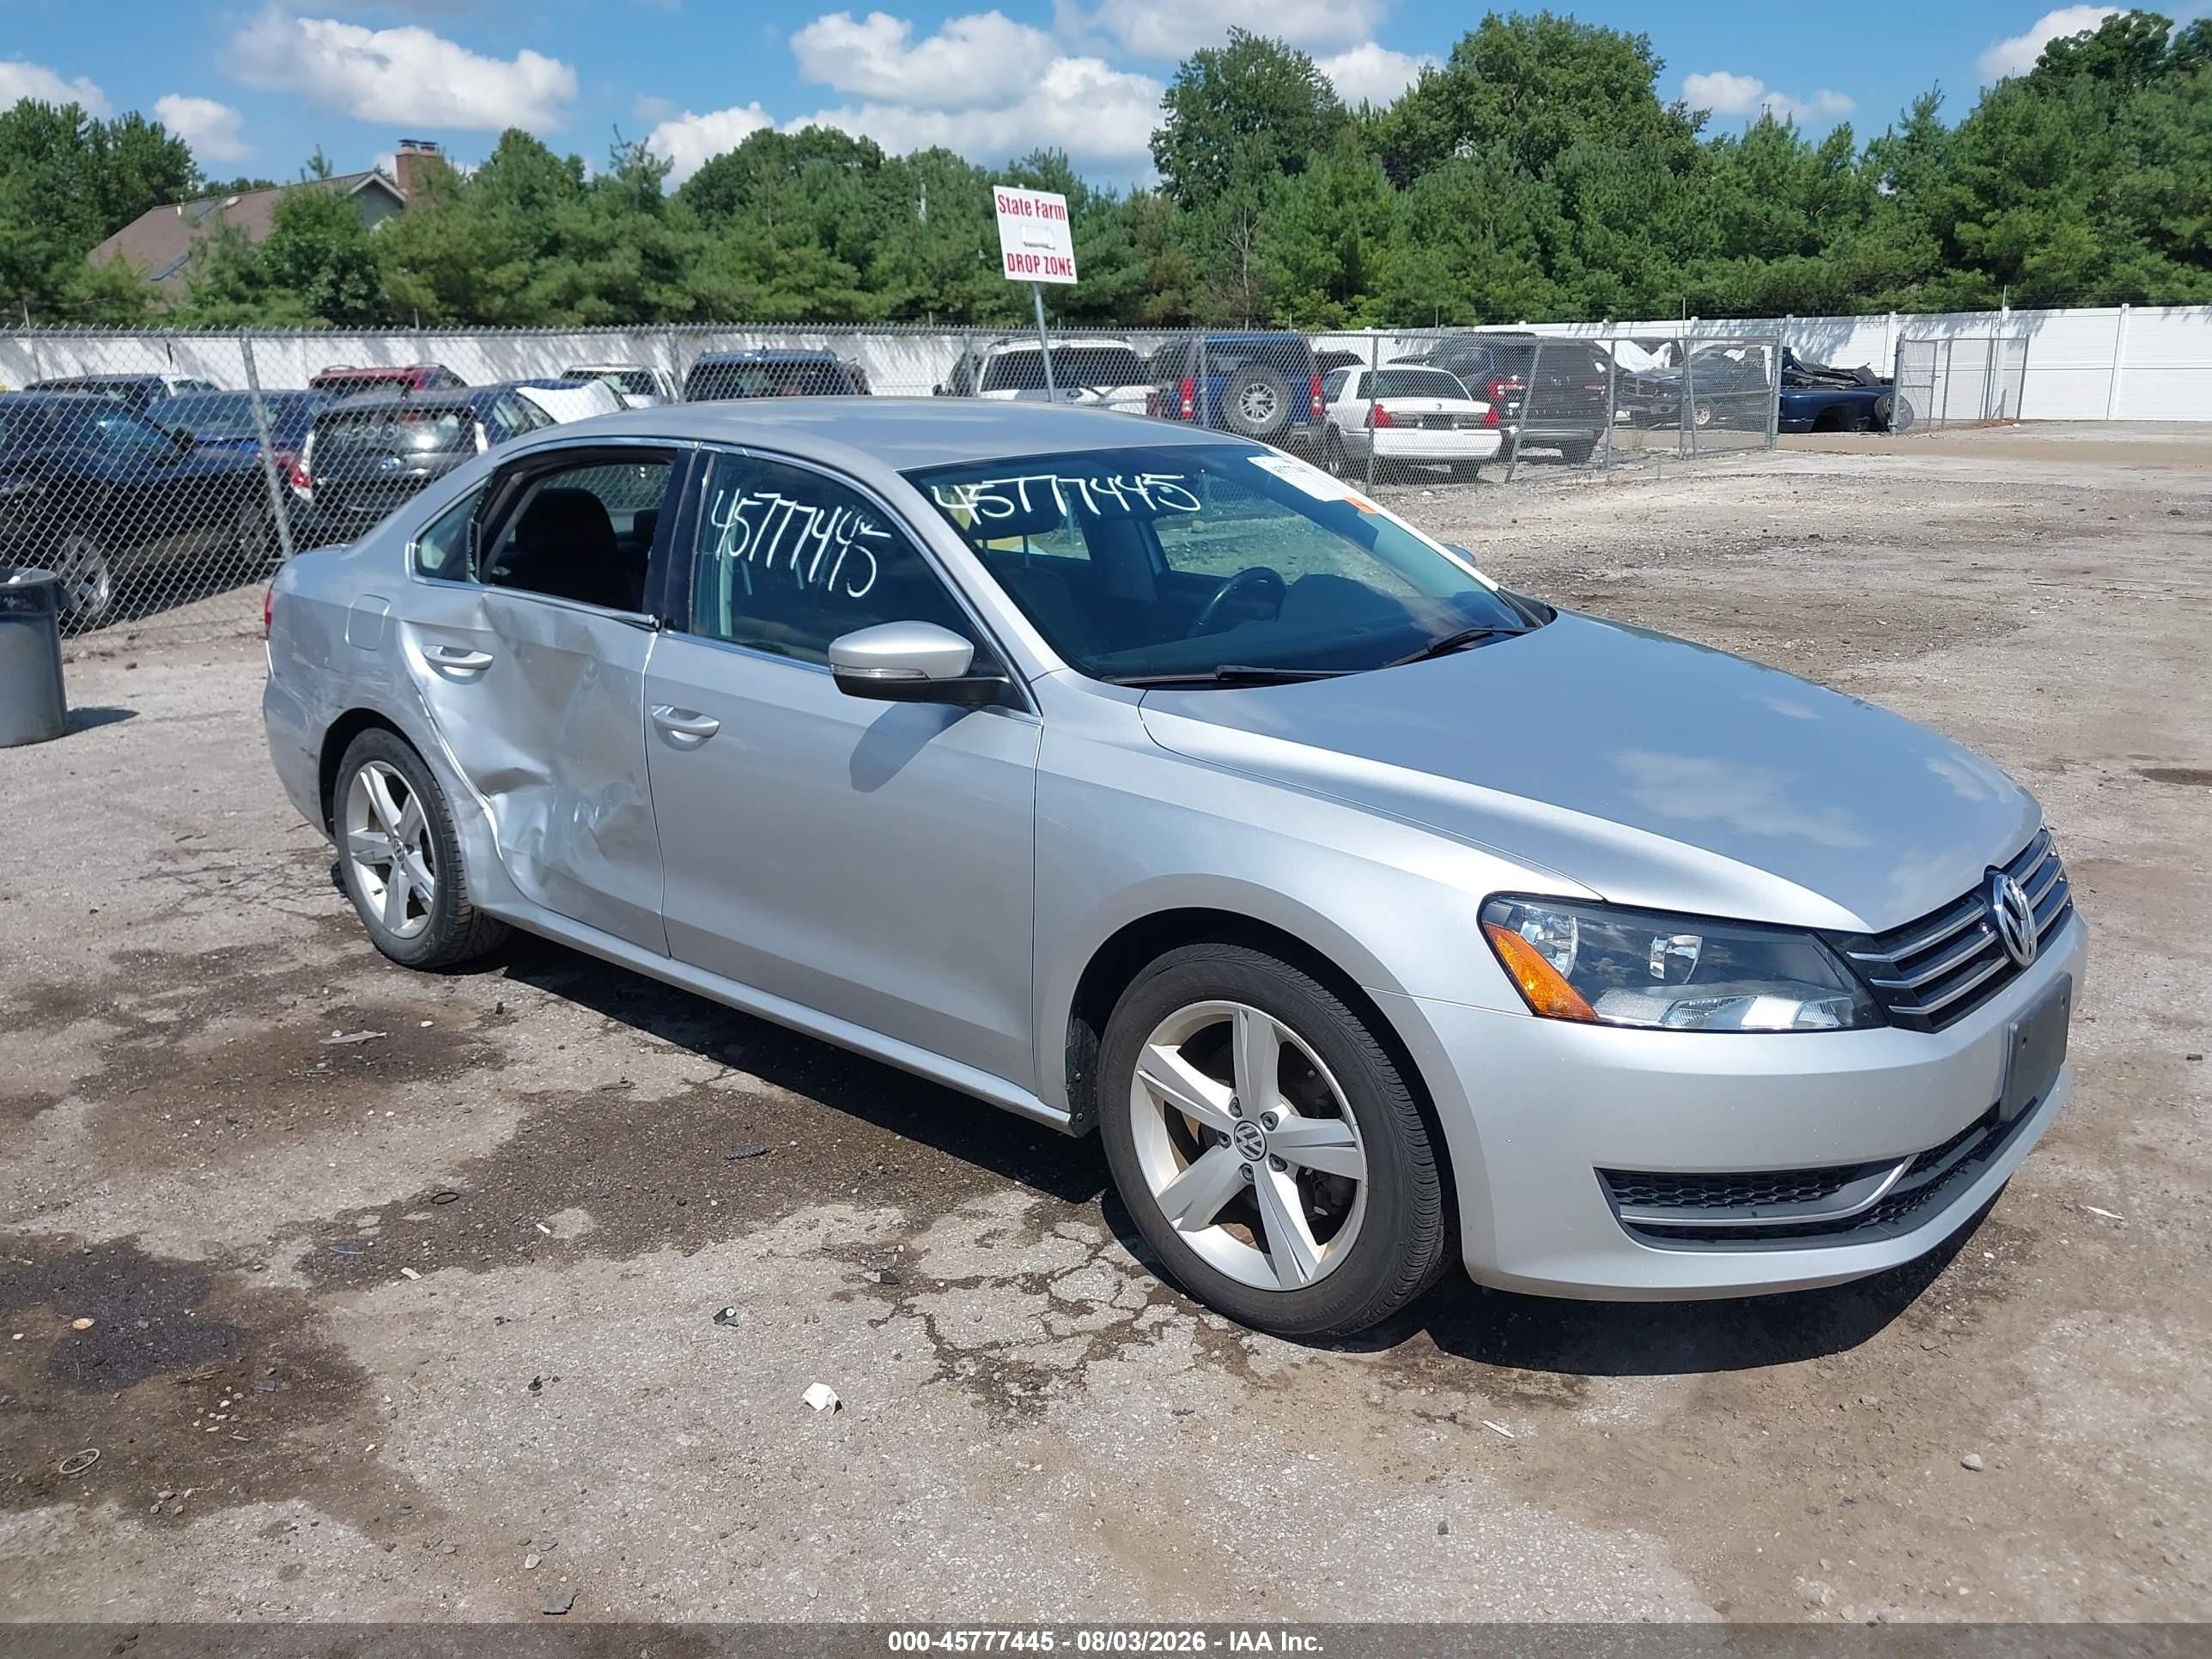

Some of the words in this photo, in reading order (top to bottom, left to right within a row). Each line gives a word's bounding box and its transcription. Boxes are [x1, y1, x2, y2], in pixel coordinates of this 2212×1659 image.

[997, 193, 1032, 217] State
[1034, 198, 1066, 221] Farm
[1006, 252, 1041, 274] DROP
[1043, 255, 1073, 276] ZONE
[930, 474, 1201, 526] 45777445
[711, 487, 892, 598] 45777445
